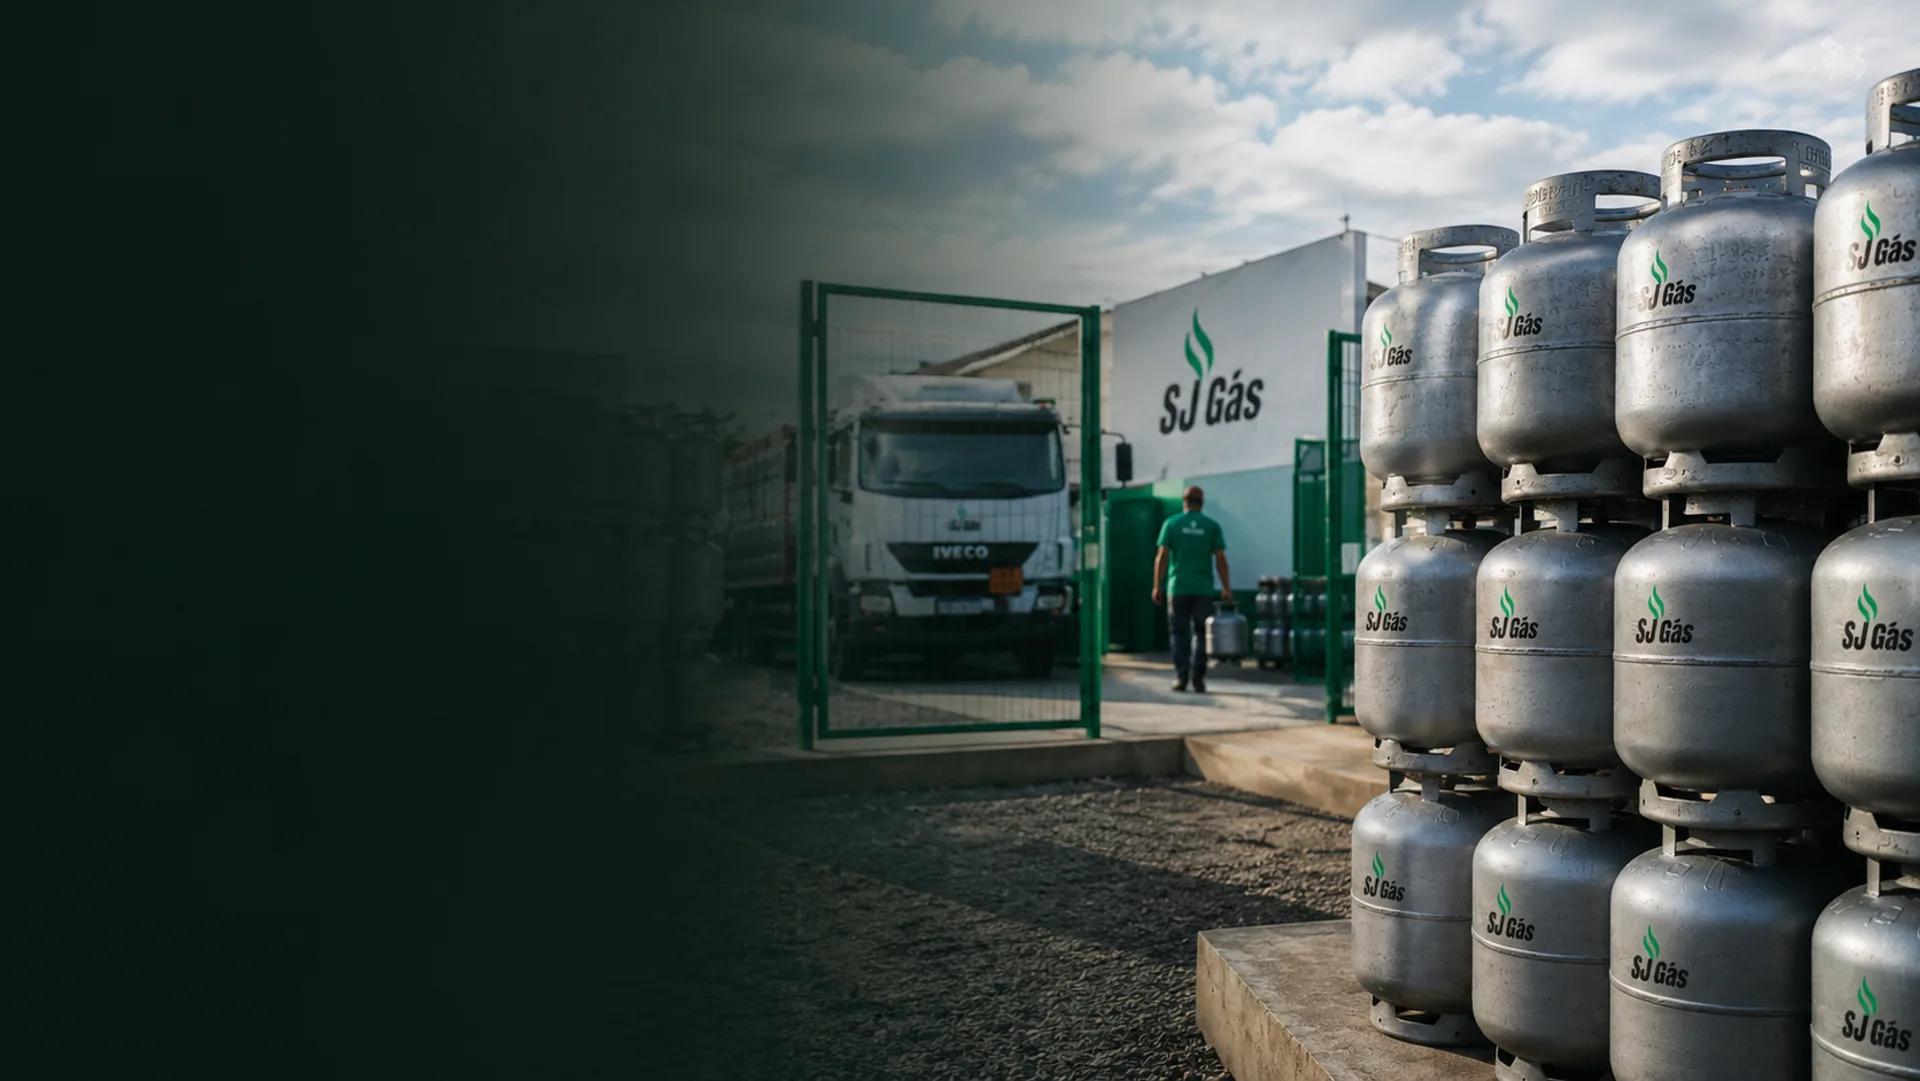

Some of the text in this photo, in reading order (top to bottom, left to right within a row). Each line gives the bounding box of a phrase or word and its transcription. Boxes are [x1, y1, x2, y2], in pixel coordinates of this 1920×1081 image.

[1845, 233, 1917, 271] SJ Gás
[1637, 279, 1697, 312] SJ Gás
[1513, 312, 1543, 337] Gás
[1370, 344, 1413, 370] SJ Gás
[1160, 367, 1264, 436] SJ Gás
[933, 545, 990, 560] IVECO
[1366, 610, 1408, 631] SJ Gás
[1490, 616, 1539, 640] SJ Gás
[1635, 617, 1695, 644] SJ Gás
[1842, 620, 1915, 652] SJ Gás
[1363, 875, 1405, 902] SJ Gás
[1487, 911, 1536, 941] SJ Gás
[1631, 954, 1689, 989] SJ Gás
[1842, 1009, 1912, 1053] SJ Gás
